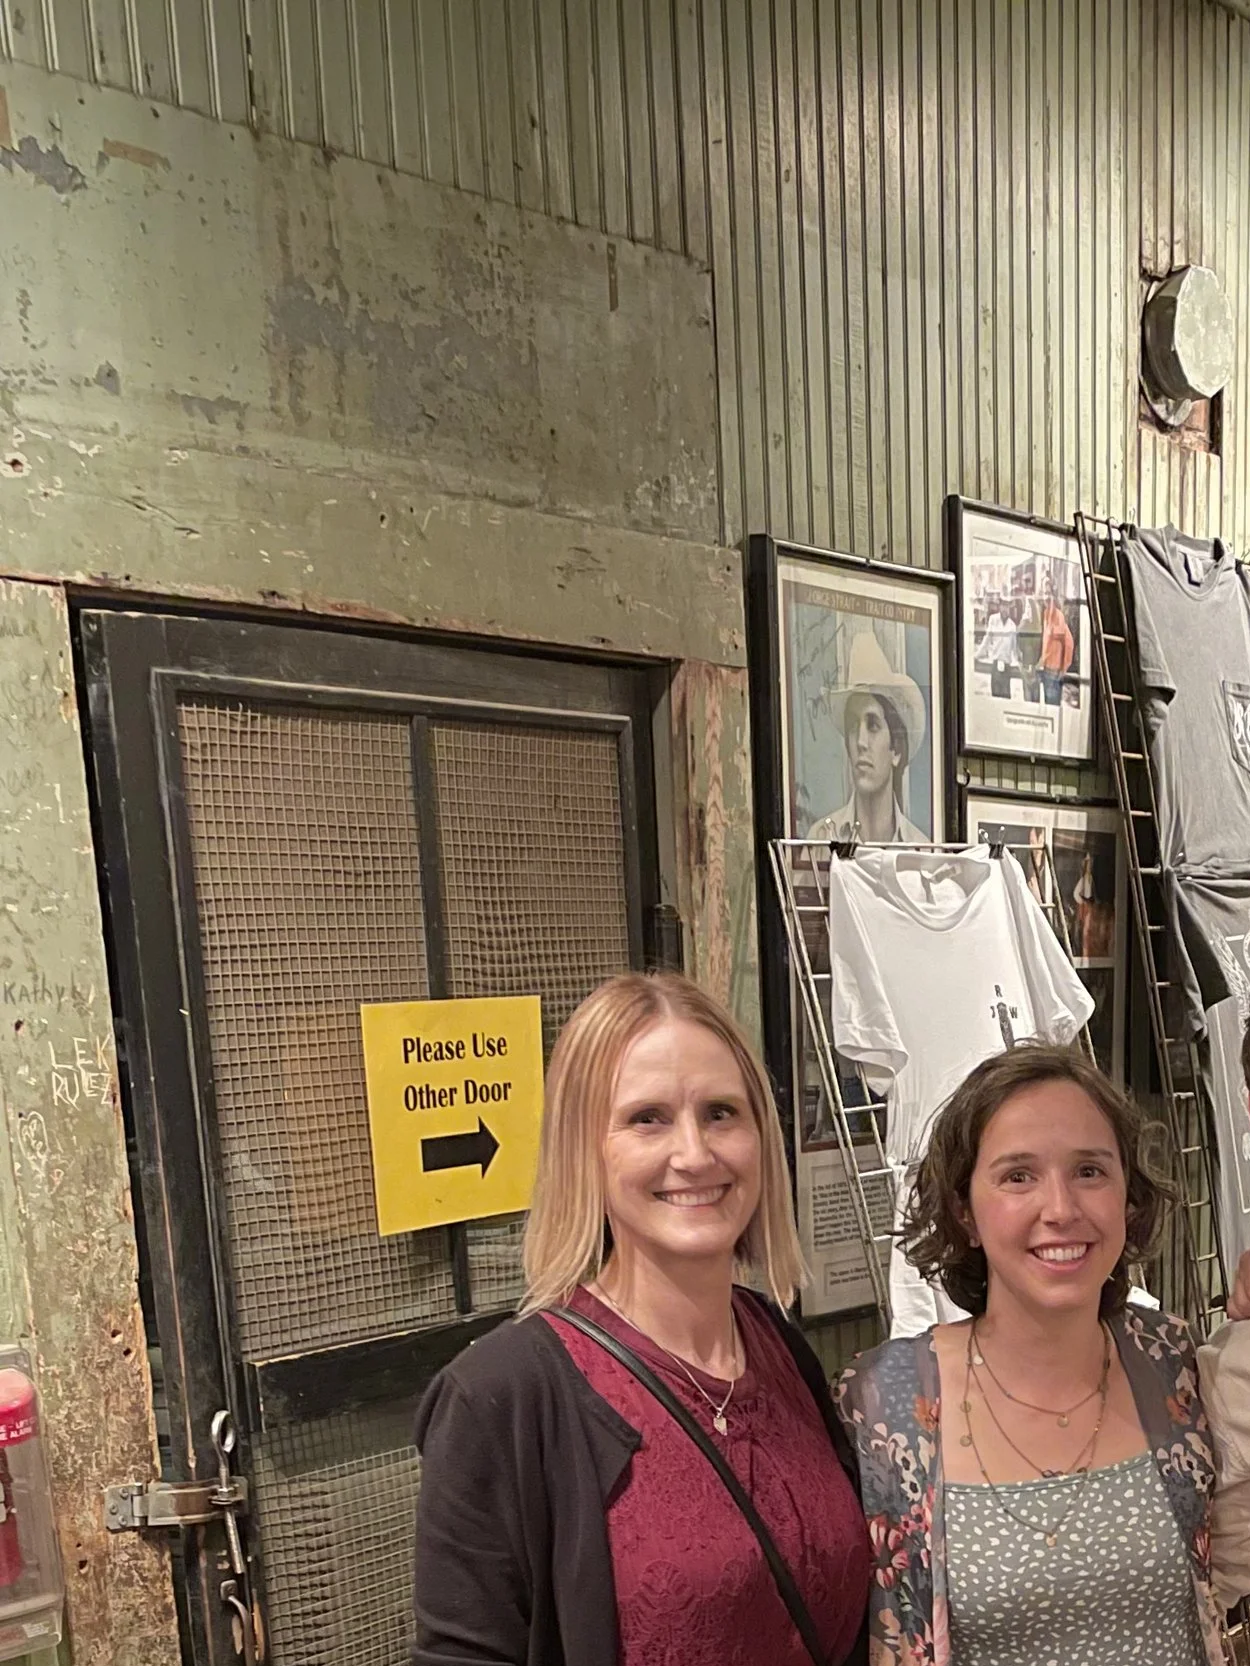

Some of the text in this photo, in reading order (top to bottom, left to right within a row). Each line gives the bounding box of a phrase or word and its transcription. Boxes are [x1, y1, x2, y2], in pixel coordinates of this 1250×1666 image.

[402, 1033, 508, 1064] Please Use
[404, 1079, 512, 1111] Other Door
